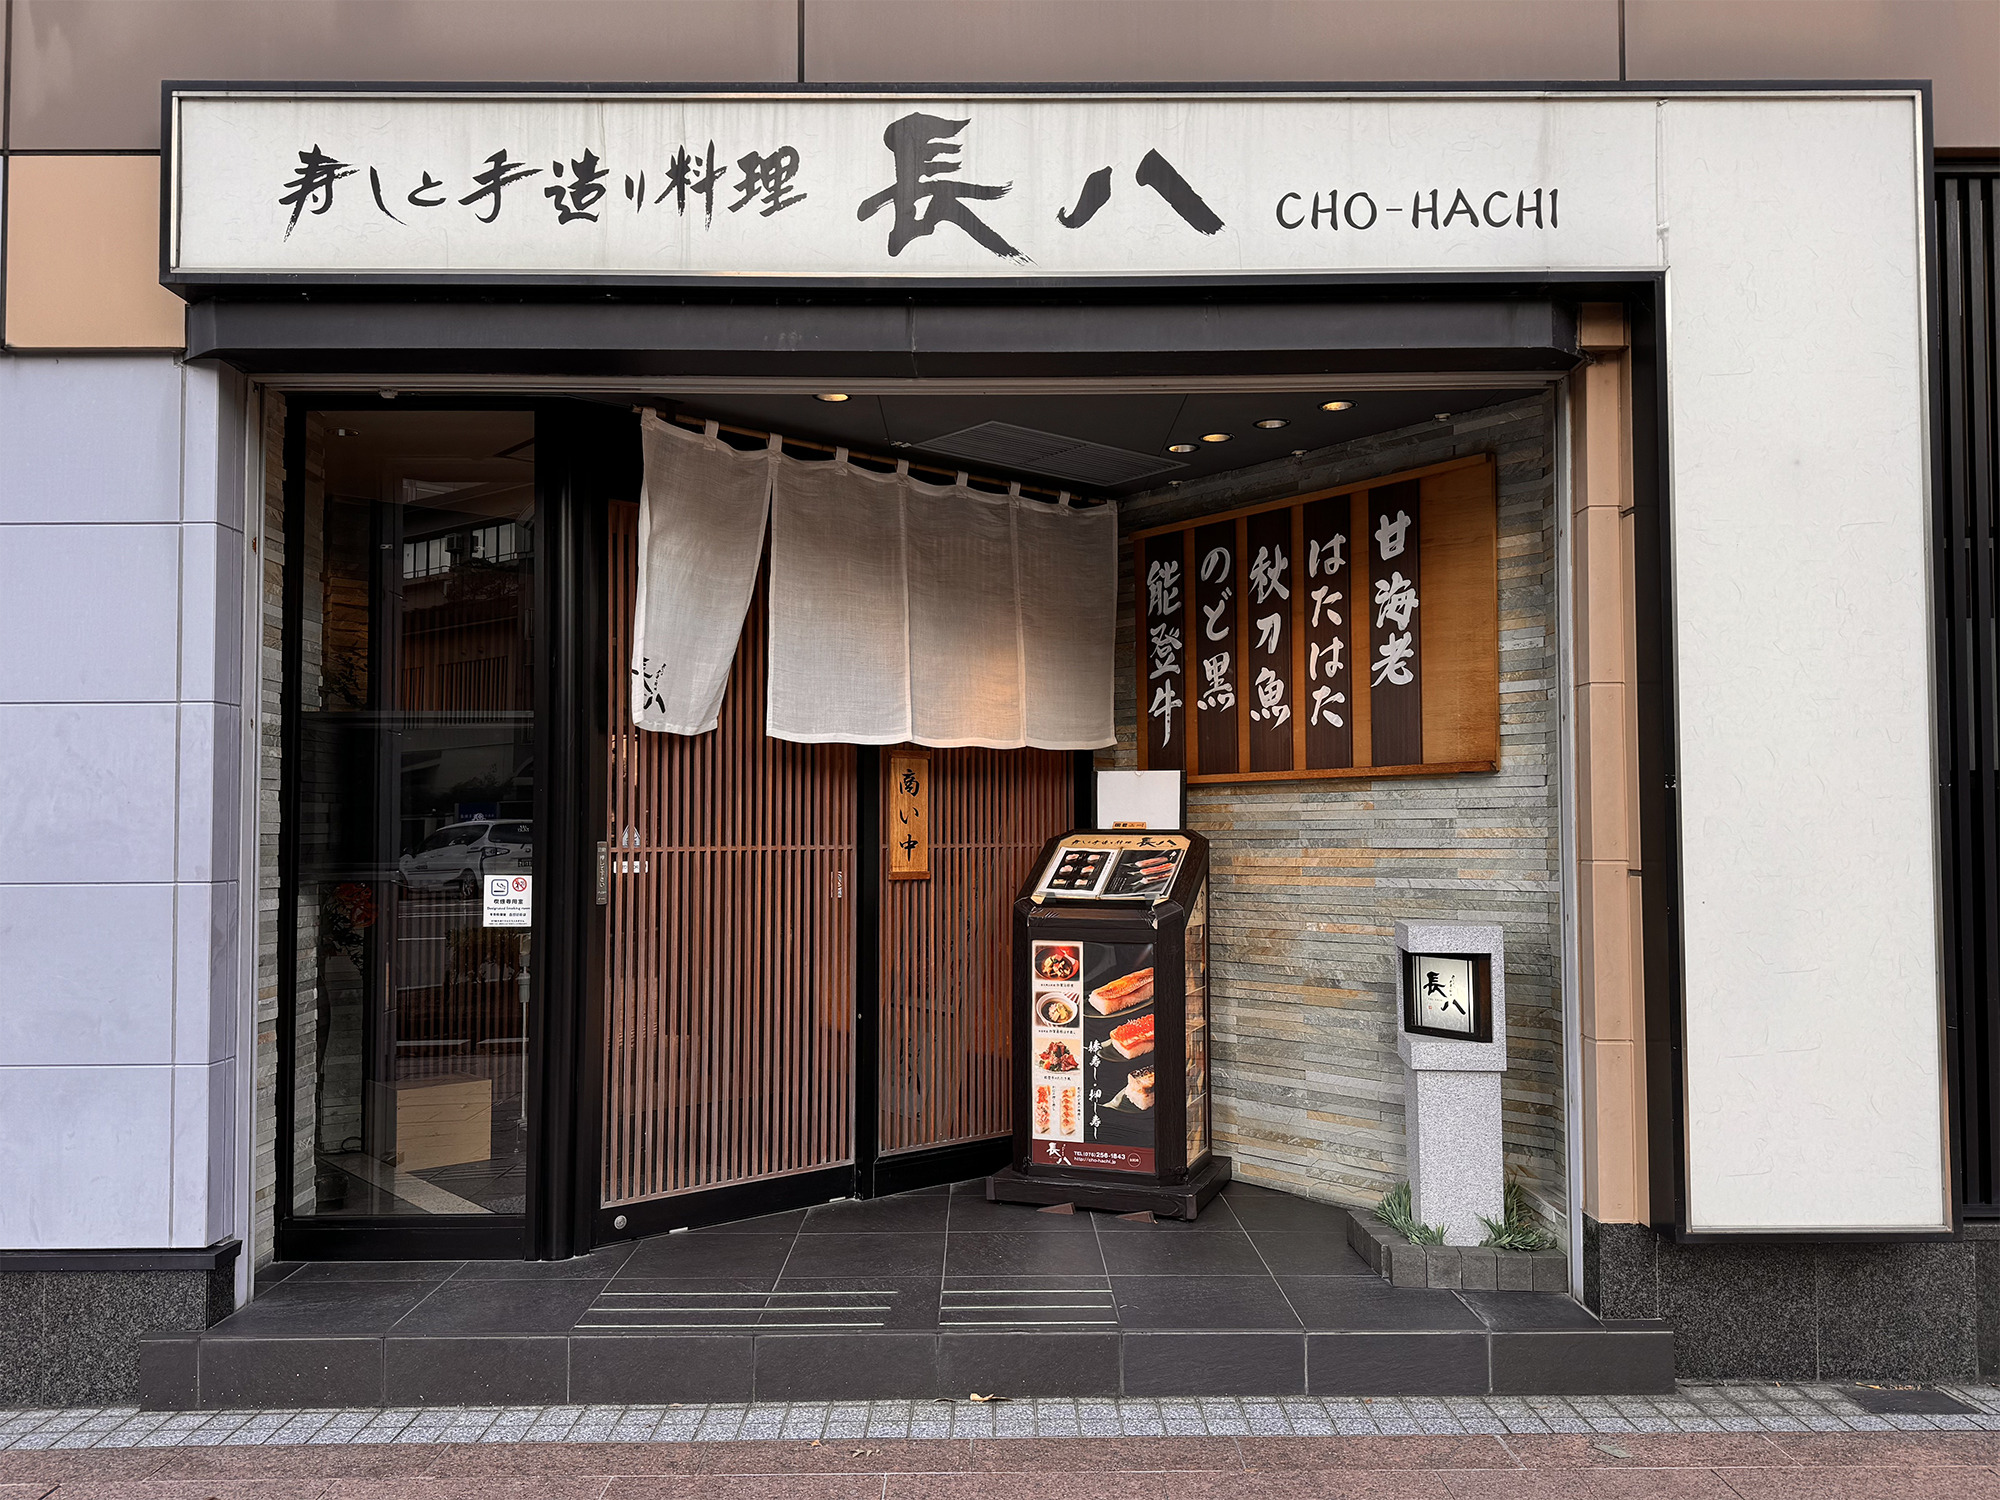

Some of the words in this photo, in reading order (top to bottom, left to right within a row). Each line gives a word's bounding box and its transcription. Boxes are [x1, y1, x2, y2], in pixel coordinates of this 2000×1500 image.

[279, 139, 807, 241] 寿しと手造り料理
[858, 112, 1225, 262] 長八
[1276, 188, 1559, 231] CHO-HACHI
[1147, 559, 1183, 749] 能登牛
[1196, 546, 1236, 712] のど黒
[1248, 544, 1291, 732] 秋刀魚
[1308, 532, 1346, 728] はたはた
[1370, 509, 1419, 688] 甘海老
[899, 768, 920, 862] 商い中
[1136, 836, 1177, 848] 長八
[1422, 971, 1466, 1016] 長八
[1045, 1141, 1073, 1167] 長八
